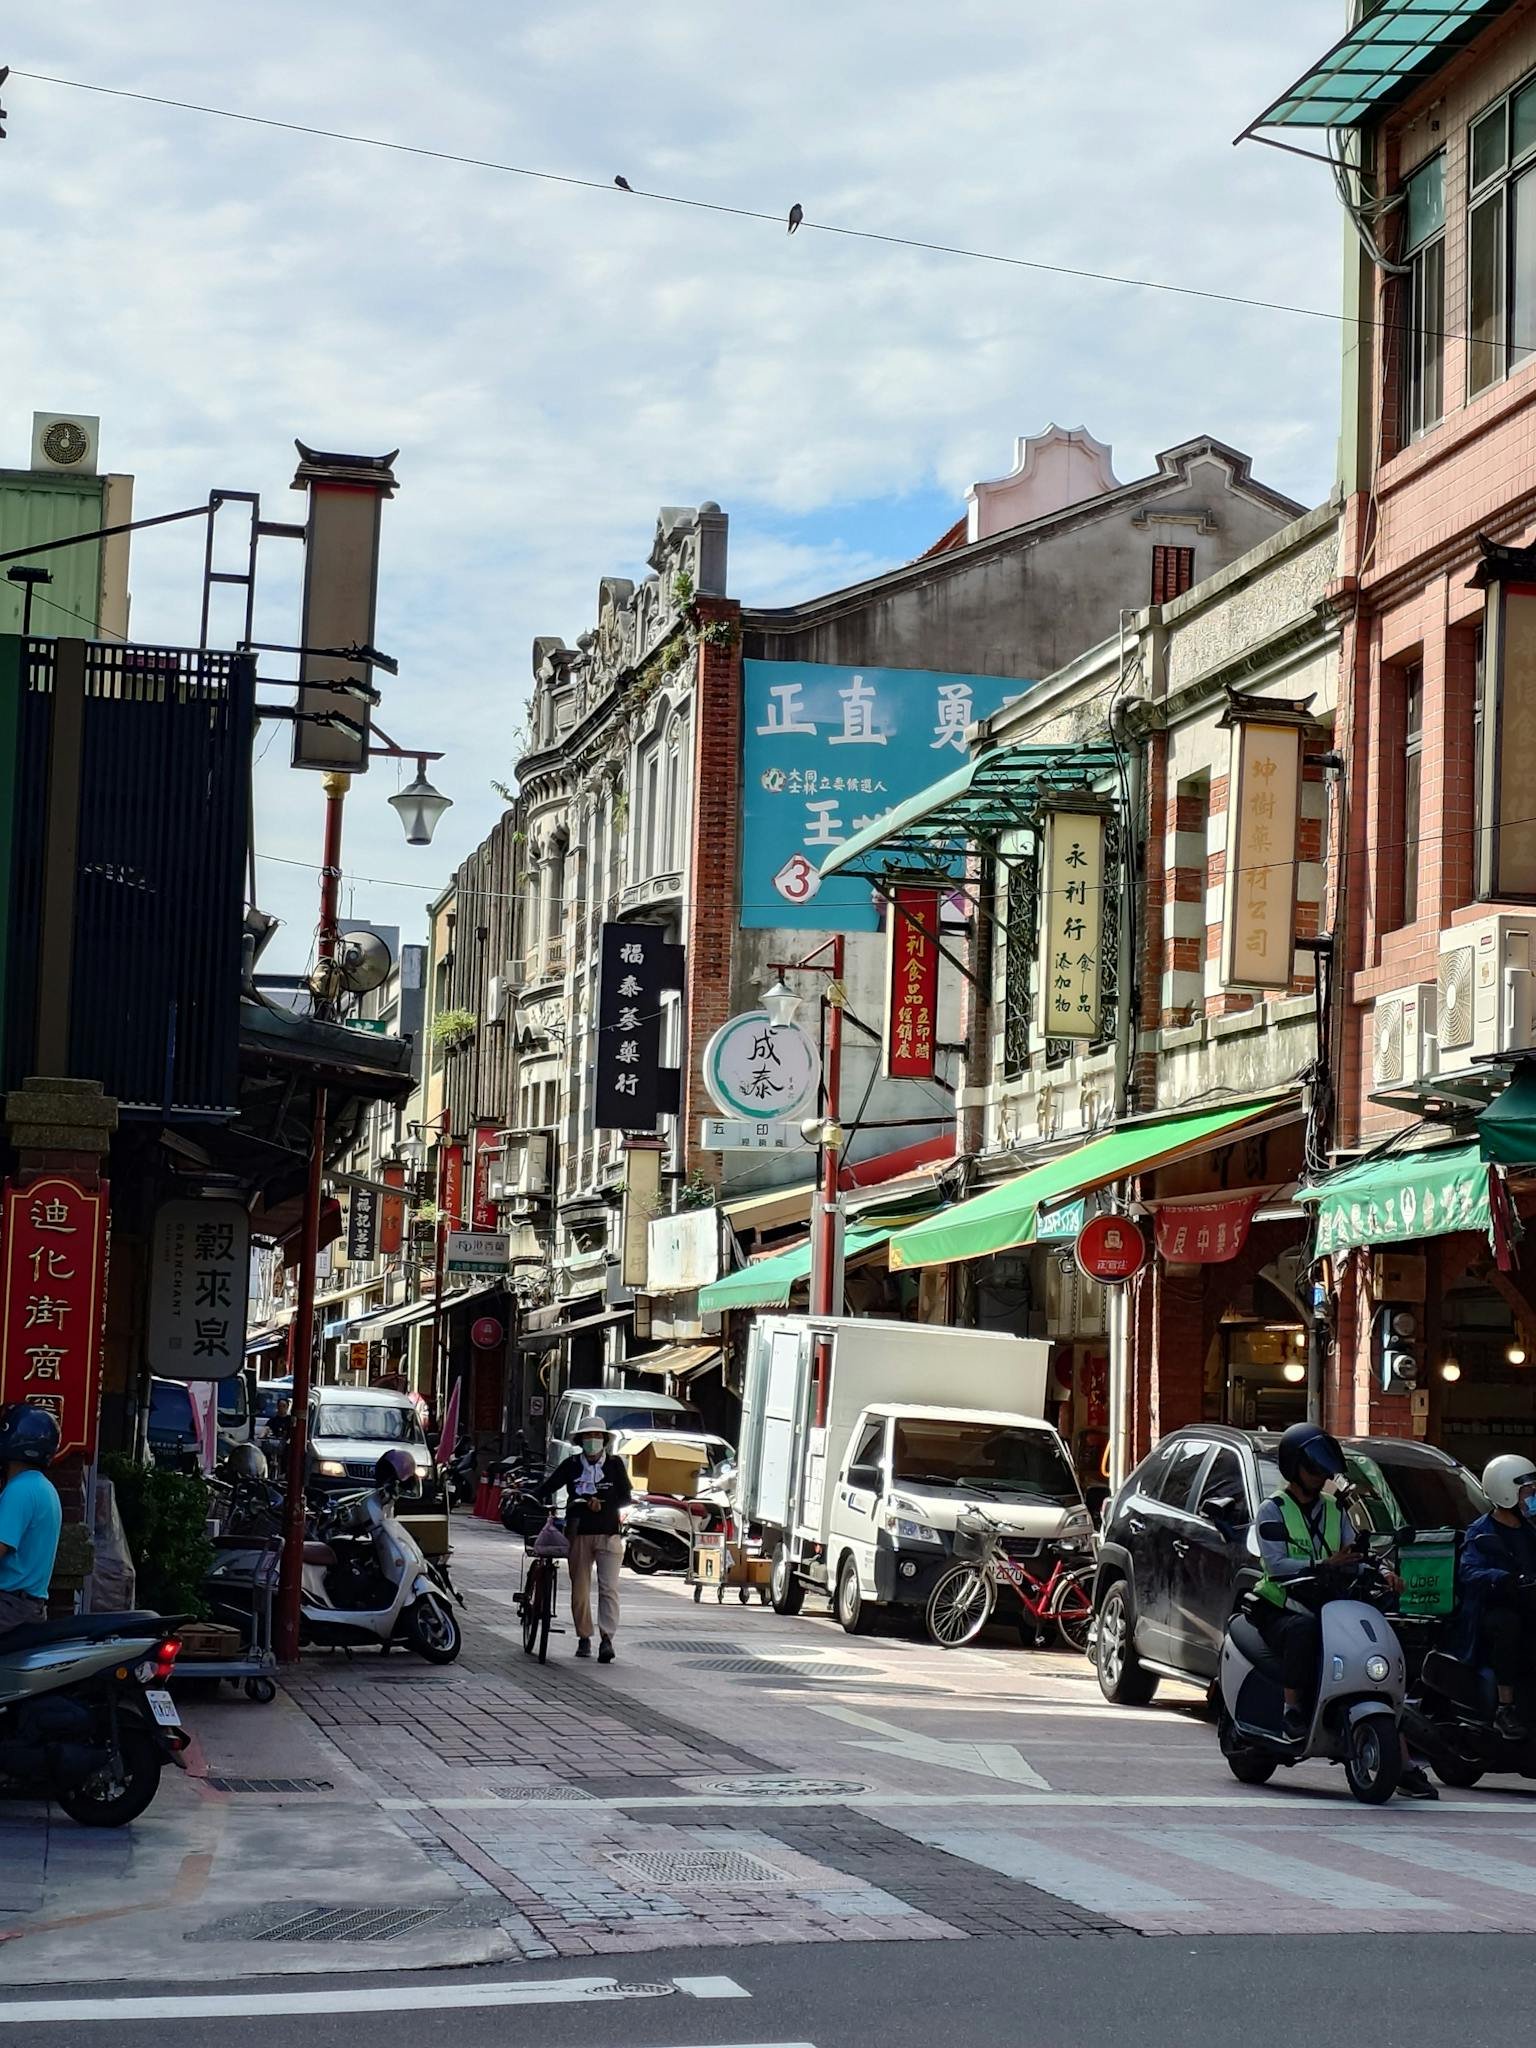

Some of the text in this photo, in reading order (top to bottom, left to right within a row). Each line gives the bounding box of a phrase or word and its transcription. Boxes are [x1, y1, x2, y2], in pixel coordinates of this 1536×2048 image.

[785, 859, 810, 898] 3
[1064, 843, 1088, 941] 永利行
[1055, 952, 1072, 1013] 添加物
[1077, 951, 1095, 1013] 食品
[747, 1028, 784, 1099] 成泰
[193, 1222, 236, 1358] 穀來泉
[1409, 1575, 1440, 1588] Uber
